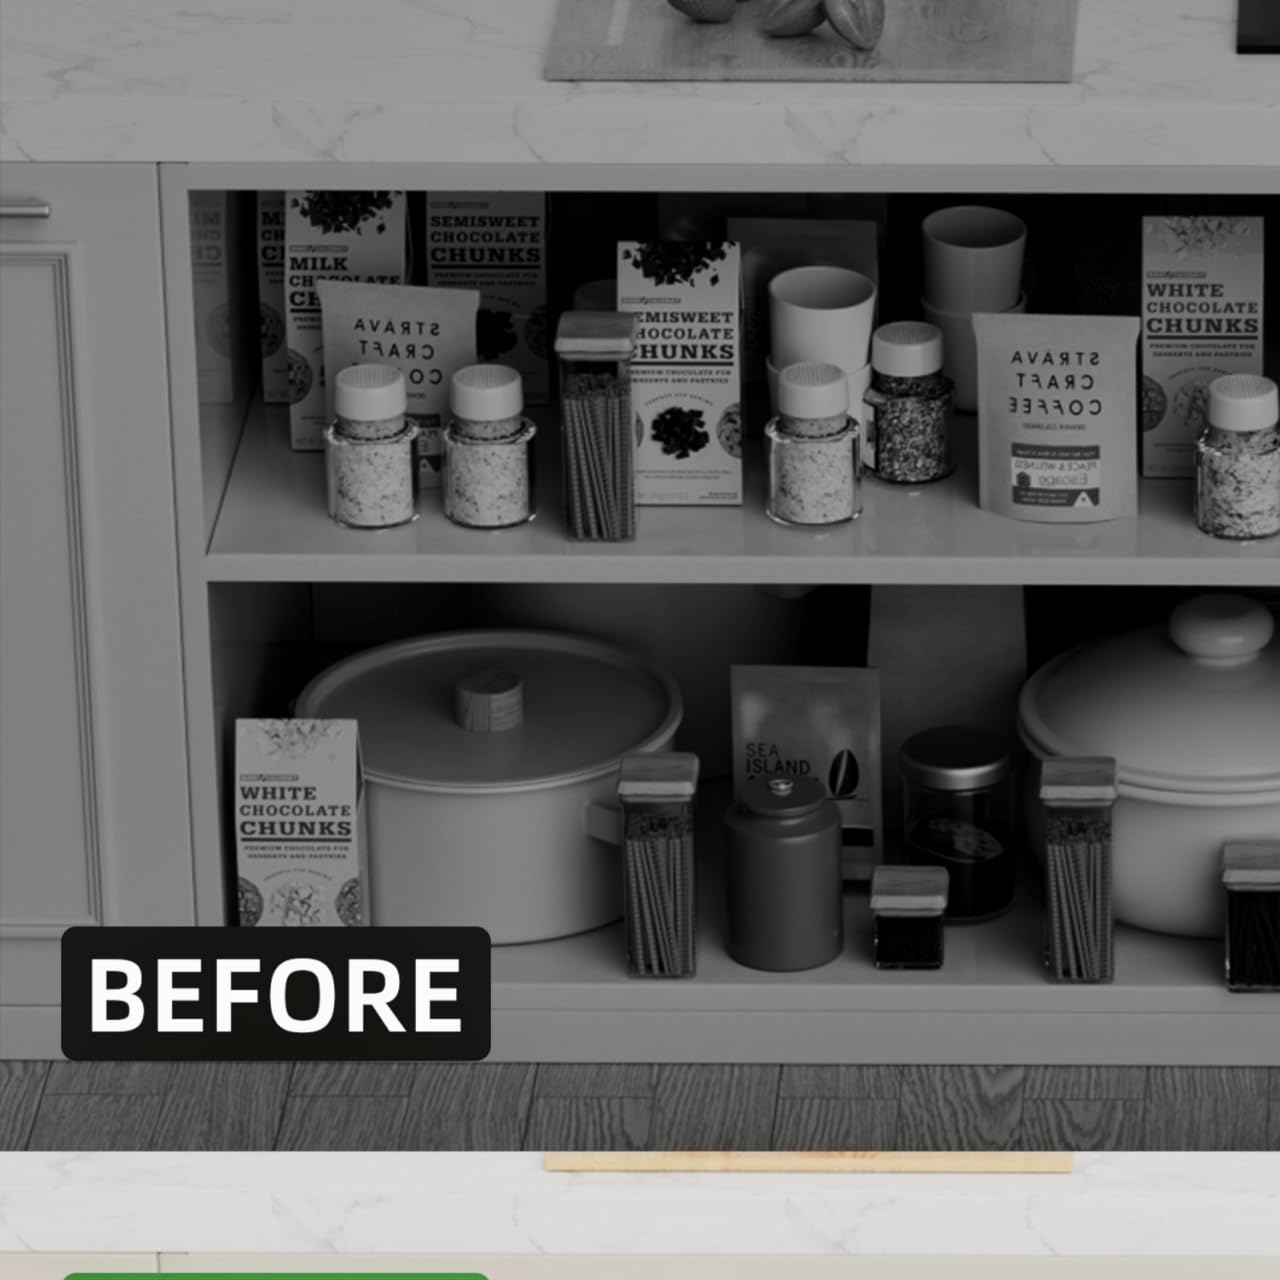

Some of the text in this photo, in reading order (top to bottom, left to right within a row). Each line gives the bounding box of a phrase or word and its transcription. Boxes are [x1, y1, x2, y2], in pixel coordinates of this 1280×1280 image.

[431, 216, 541, 228] SEMISWEET
[431, 231, 541, 243] CHOCOLATE
[431, 247, 541, 262] CHUNKS
[290, 257, 348, 271] MILK
[1147, 283, 1224, 297] WHITE
[1146, 302, 1258, 314] CHOCOLATE
[632, 311, 734, 323] EMISWEET
[1146, 318, 1258, 333] CHUNKS
[634, 328, 734, 340] HOCOLATE
[746, 743, 779, 759] SEA
[746, 758, 811, 776] ISLAND
[240, 786, 317, 801] WHITE
[240, 804, 351, 817] CHOCOLATE
[240, 821, 352, 836] CHUNKS
